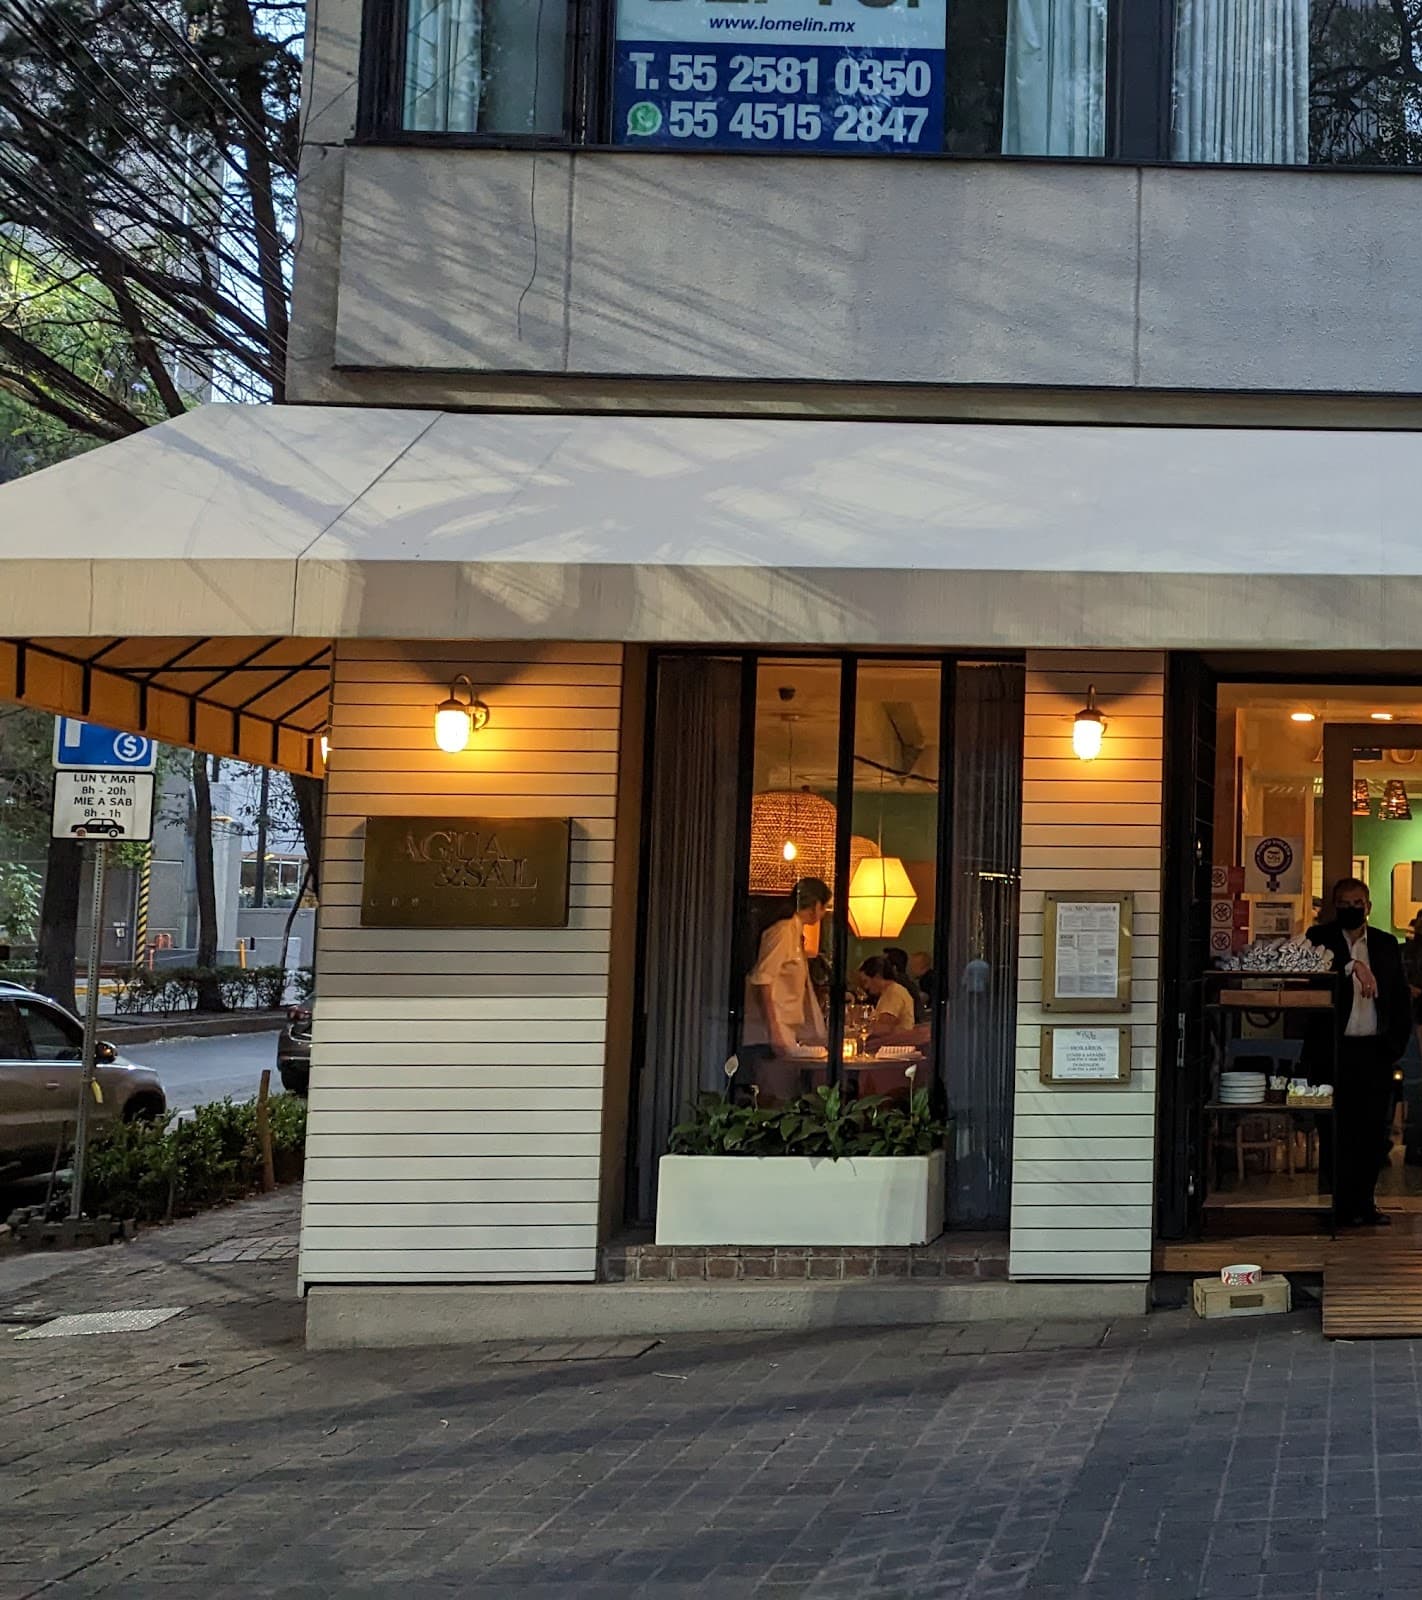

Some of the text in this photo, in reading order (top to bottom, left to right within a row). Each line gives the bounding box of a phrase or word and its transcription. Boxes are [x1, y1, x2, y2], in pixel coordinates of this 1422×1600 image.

[709, 15, 856, 34] www.lomelin.mx
[629, 52, 932, 98] T. 55 2581 0350
[669, 101, 930, 144] 55 4515 2847
[74, 774, 96, 783] LUN
[110, 775, 135, 784] MAR
[82, 785, 95, 795] 8h
[107, 786, 127, 796] 20h
[74, 797, 133, 807] MIE A SAB
[84, 808, 97, 817] 8h
[109, 808, 121, 818] 1h
[395, 830, 510, 863] AGUA
